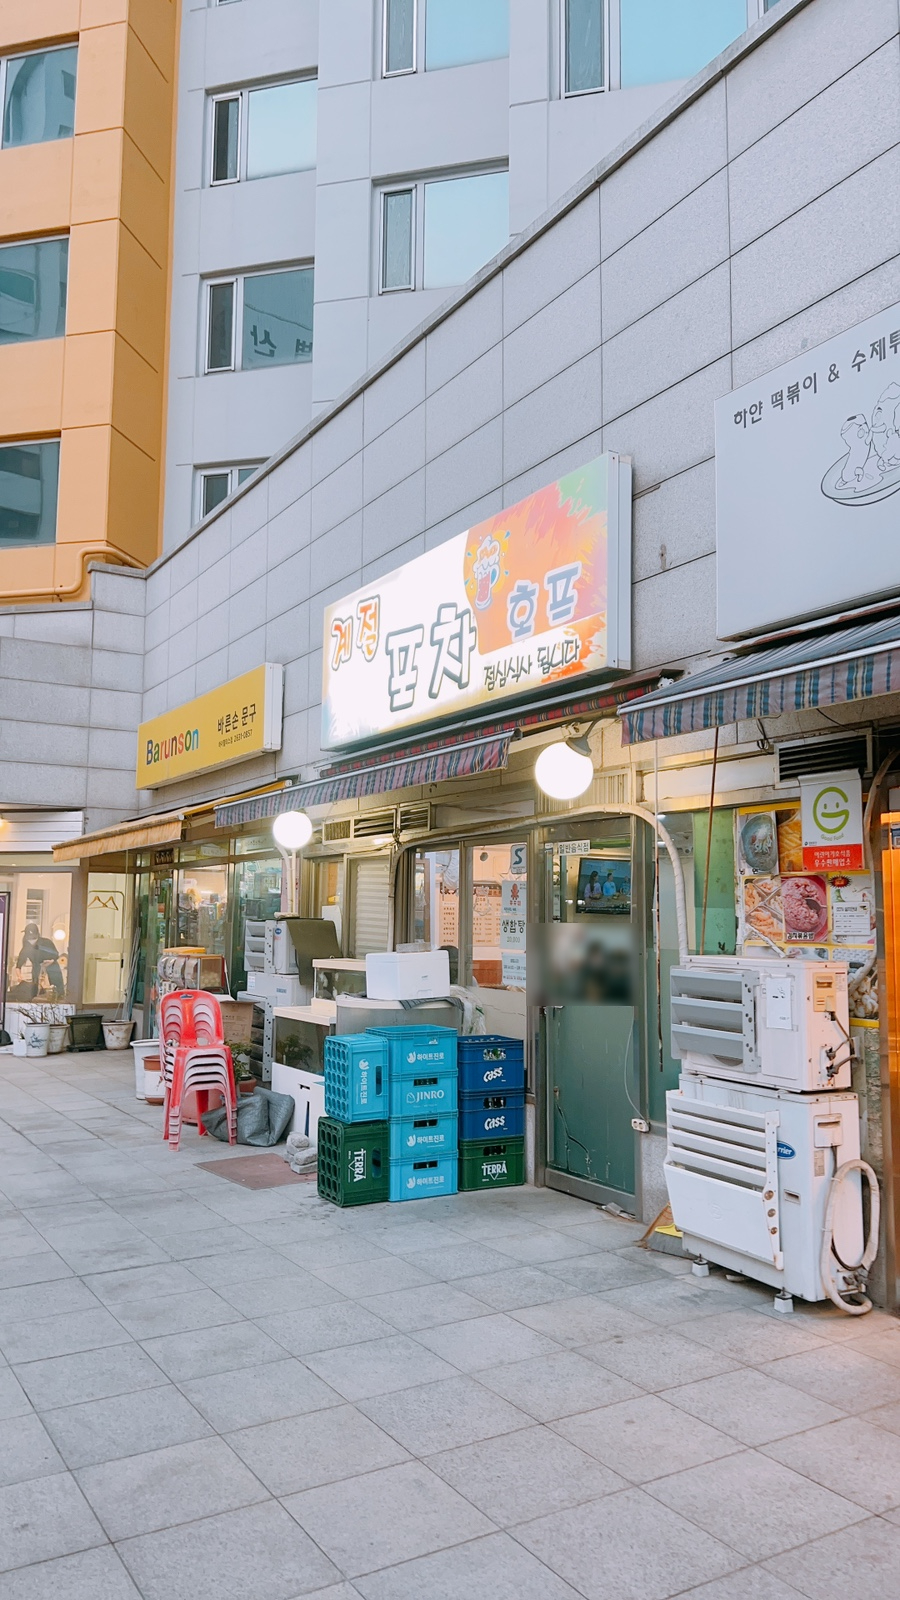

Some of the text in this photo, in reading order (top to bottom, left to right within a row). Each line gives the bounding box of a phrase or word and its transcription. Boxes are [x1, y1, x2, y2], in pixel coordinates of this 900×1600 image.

[733, 401, 763, 428] 하얀
[771, 372, 817, 410] 떡볶이
[828, 363, 840, 383] &
[507, 561, 582, 642] 호프
[484, 639, 580, 691] 점심식사 됩니다
[217, 703, 257, 735] 바른손 문구
[146, 728, 199, 765] Barunson
[559, 842, 589, 854] 일반음식점
[814, 858, 851, 868] 우수판매업소
[501, 920, 525, 934] 생합탕
[416, 1051, 445, 1061] 하이트진로
[360, 1071, 368, 1105] 하이트진로
[415, 1089, 445, 1103] JINRO
[416, 1134, 445, 1144] 하이트진로
[354, 1148, 366, 1183] TERRA
[481, 1160, 508, 1176] TERRA
[416, 1175, 445, 1186] 하이트진로
